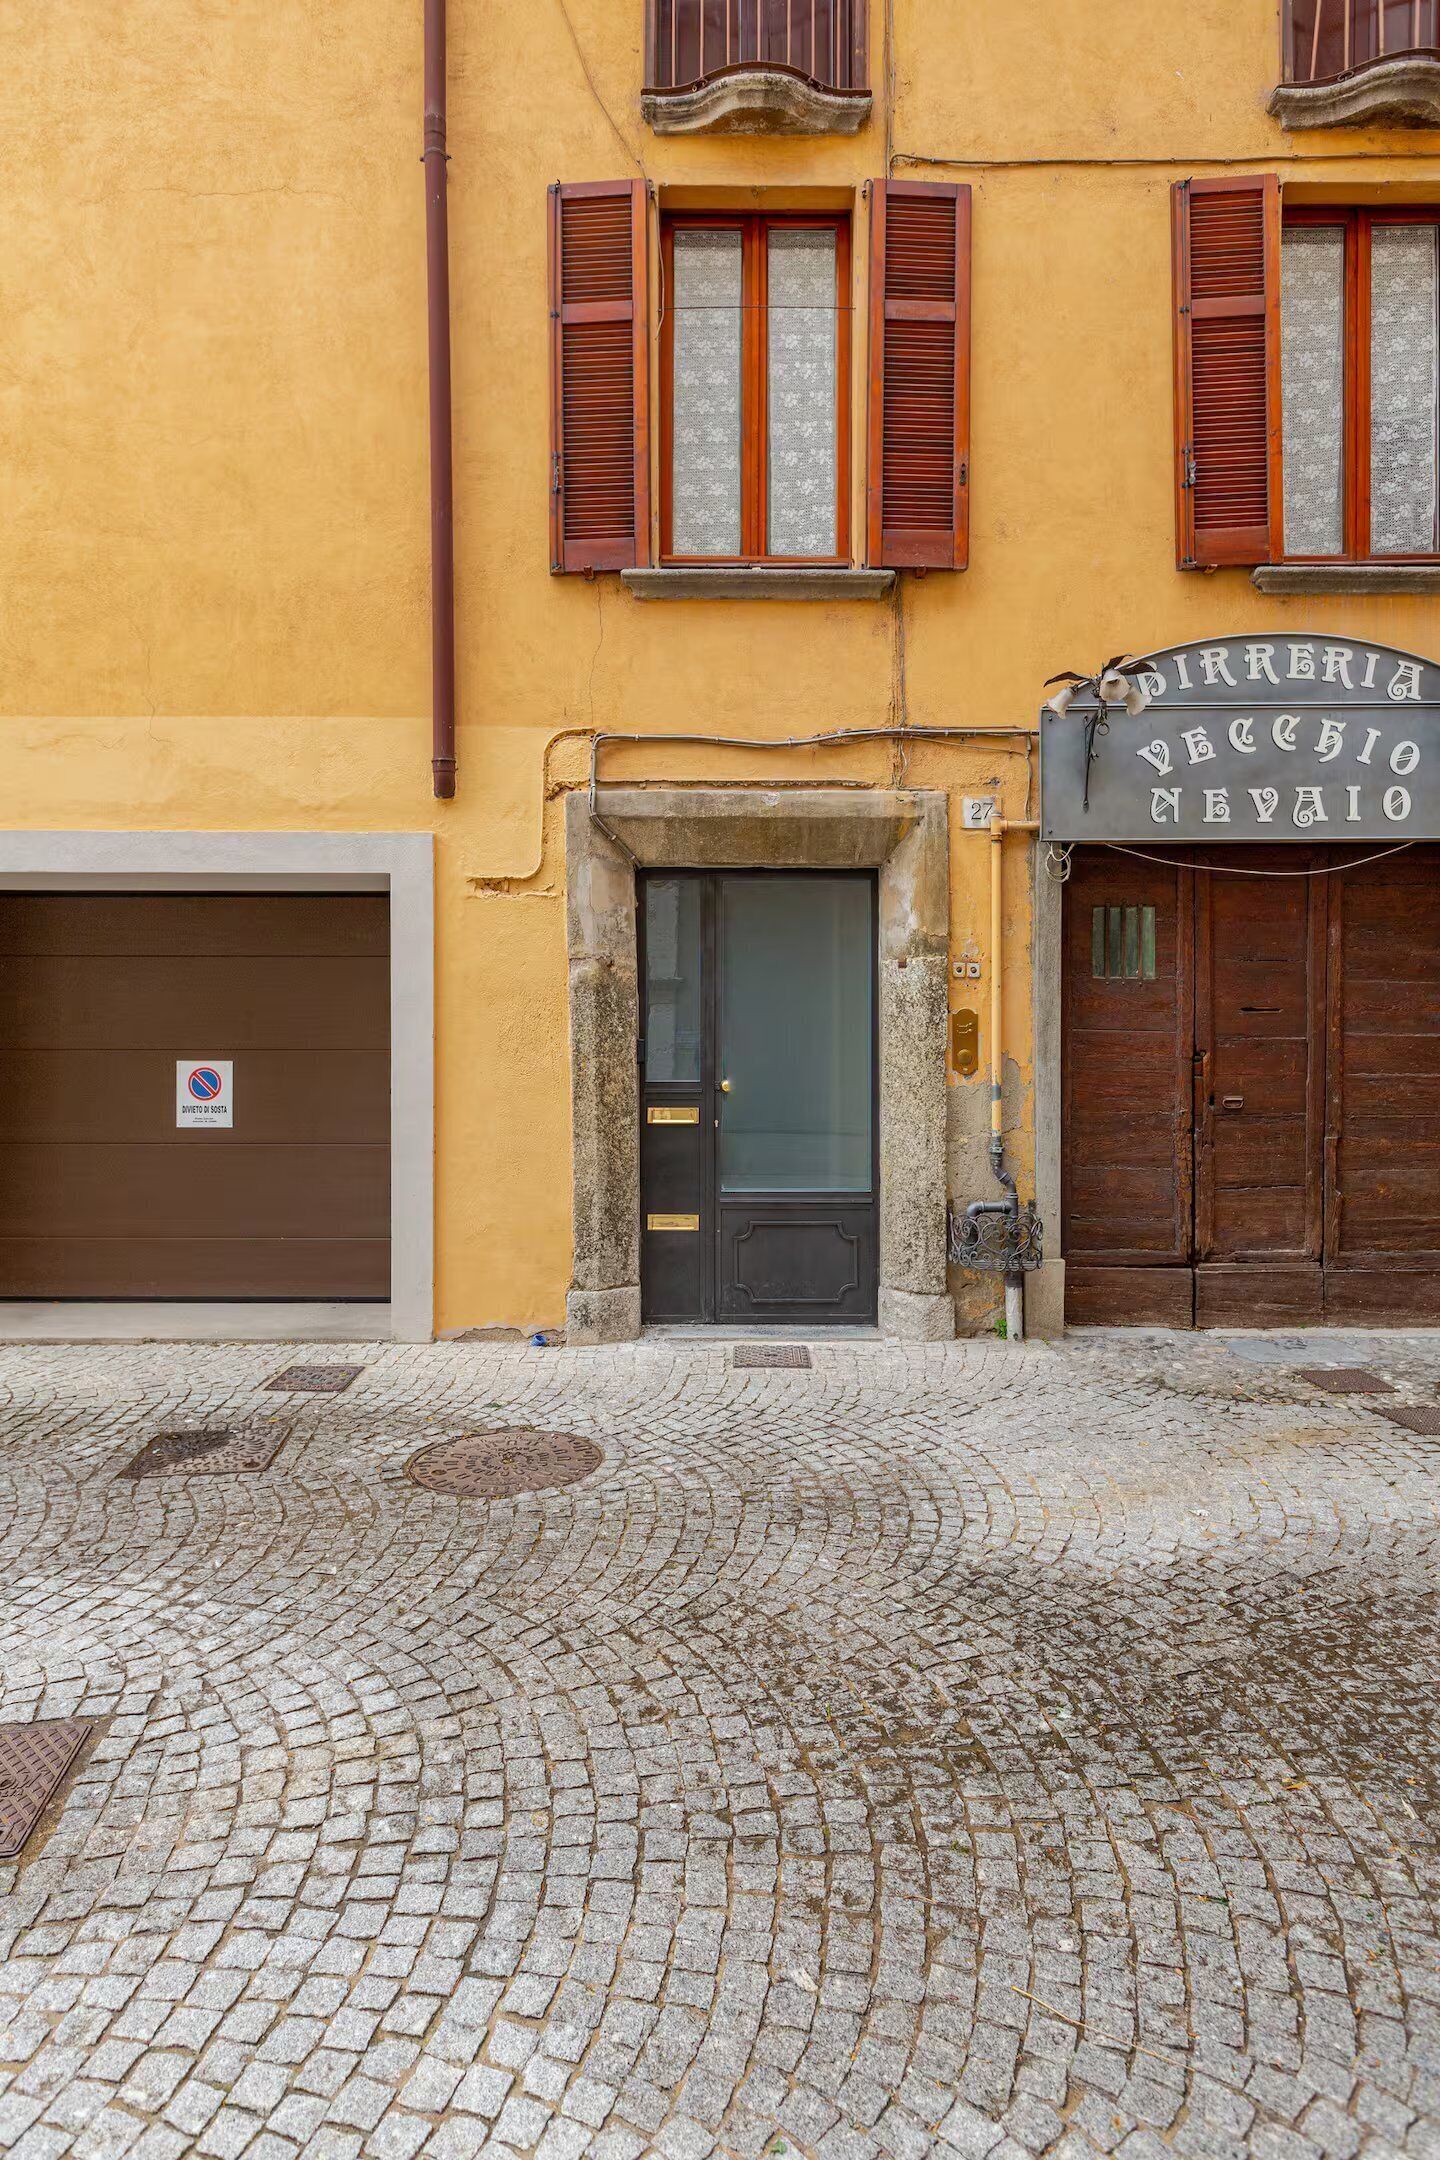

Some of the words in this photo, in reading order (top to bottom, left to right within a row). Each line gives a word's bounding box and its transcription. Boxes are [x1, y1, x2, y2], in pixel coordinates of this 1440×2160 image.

[1136, 713, 1420, 776] VECCHIO
[971, 802, 993, 820] 27
[1150, 785, 1412, 828] NEVAIO
[182, 1105, 203, 1114] DIVIETO
[204, 1105, 210, 1114] DI
[211, 1105, 228, 1114] SOSTA
